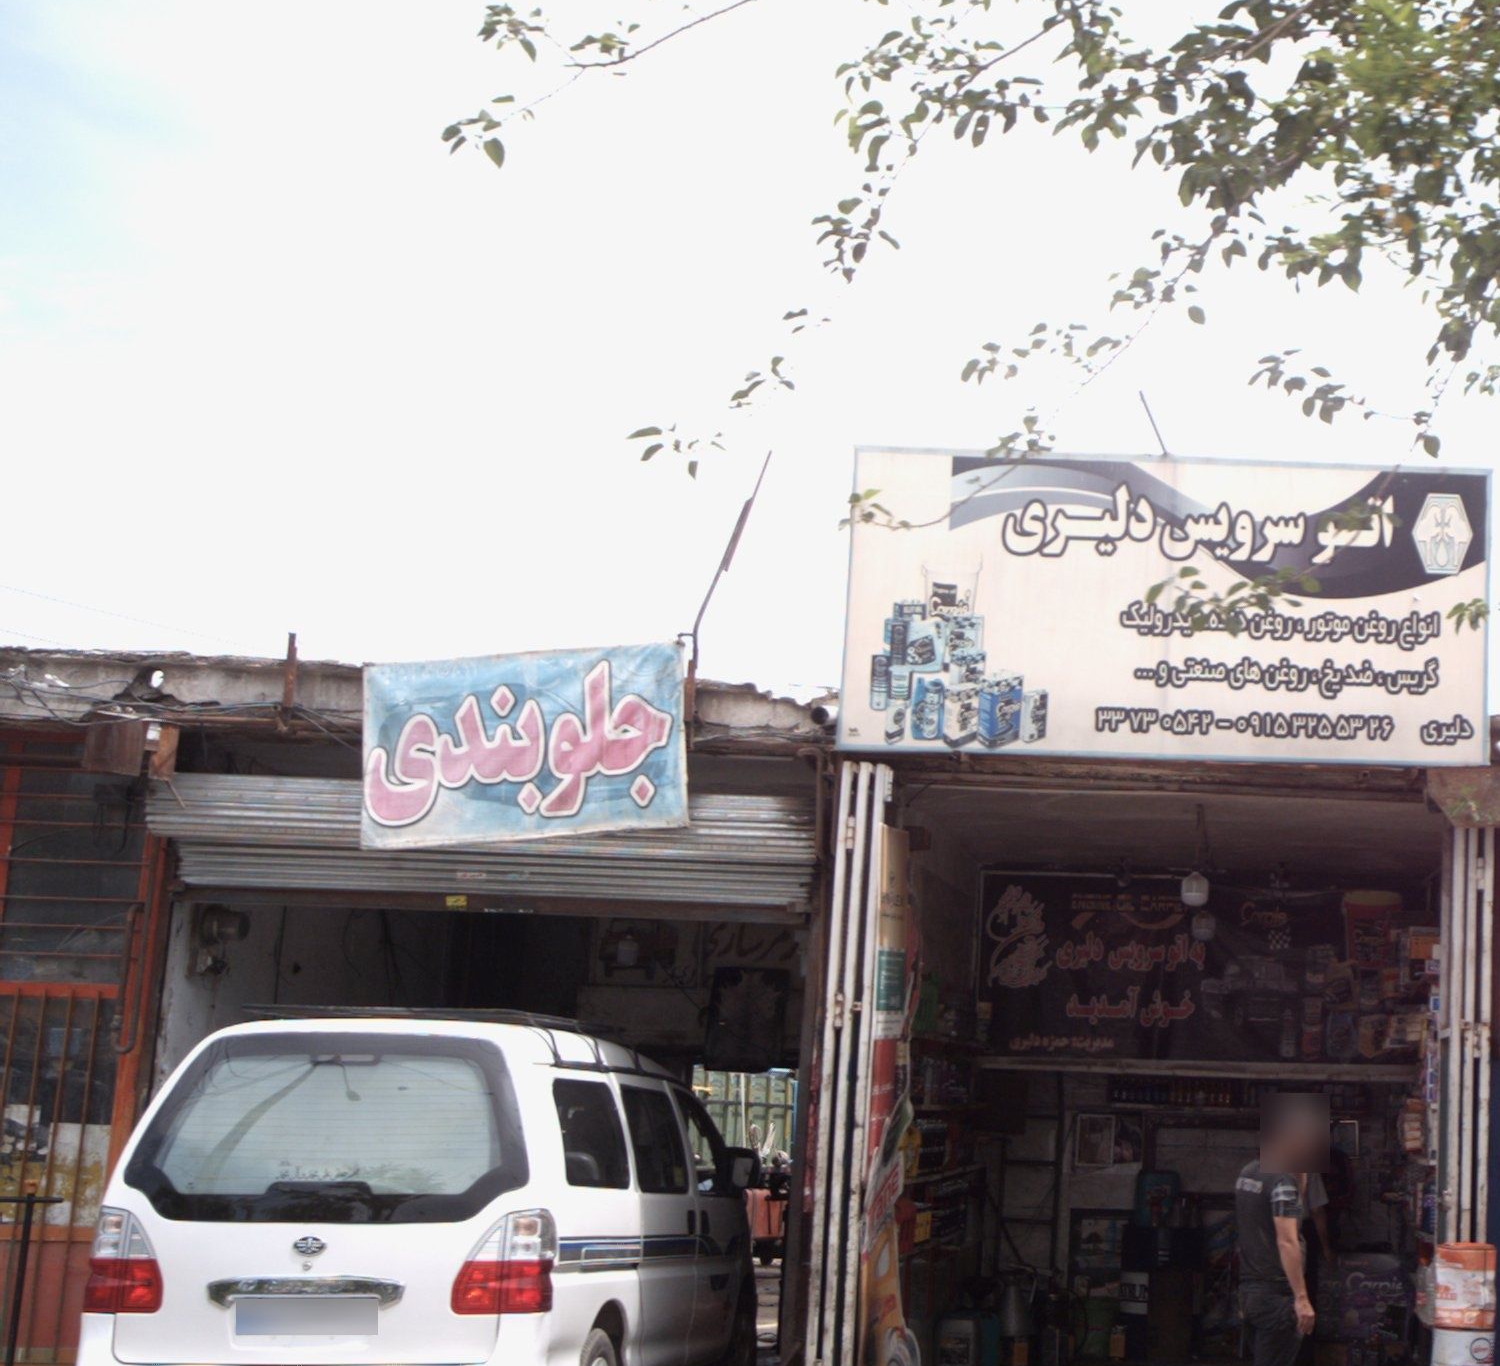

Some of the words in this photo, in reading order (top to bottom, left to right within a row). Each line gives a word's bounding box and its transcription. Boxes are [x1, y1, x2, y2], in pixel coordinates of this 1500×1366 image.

[1002, 483, 1158, 558] دلیری
[1160, 501, 1307, 562] سرویس
[1119, 600, 1203, 636] یدرولیک
[1208, 610, 1249, 634] ده
[1250, 609, 1296, 640] روغن
[1304, 611, 1352, 642] موتور
[1353, 610, 1398, 642] روغن
[1400, 611, 1441, 650] انواع
[1154, 660, 1170, 687] و
[1171, 656, 1228, 686] صنعتی
[1229, 657, 1262, 689] های
[1263, 656, 1308, 691] روغن
[1318, 658, 1342, 699] یخ
[1343, 659, 1374, 685] ضد
[1386, 657, 1439, 695] گریس
[364, 659, 673, 827] جلوبندی
[1420, 715, 1474, 745] دلیری
[1056, 930, 1105, 969] دلیری
[1108, 940, 1166, 971] سرویس
[1066, 984, 1142, 1025] آمدید
[1140, 989, 1196, 1027] خوش
